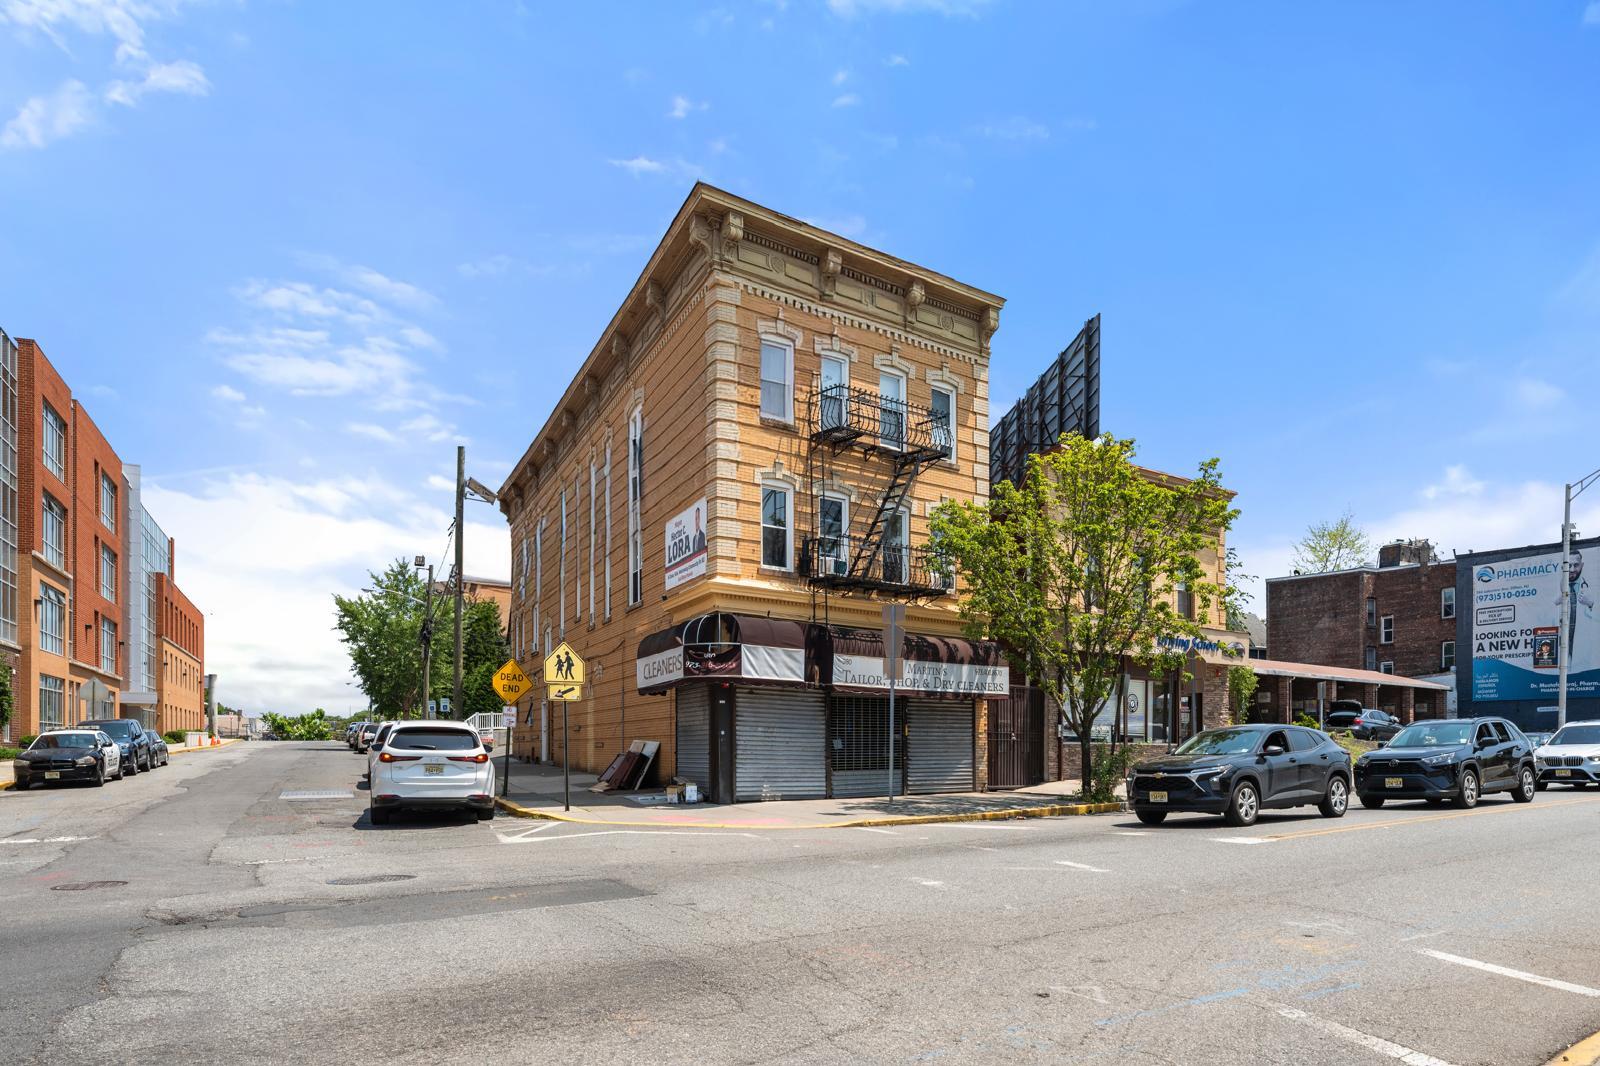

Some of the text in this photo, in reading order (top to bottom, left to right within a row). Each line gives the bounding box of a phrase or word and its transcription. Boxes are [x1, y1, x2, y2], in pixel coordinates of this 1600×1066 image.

[668, 535, 691, 564] LORA
[1497, 563, 1559, 579] PHARMACY
[1476, 588, 1537, 604] (973)510-0250
[1475, 629, 1517, 641] LOOKING
[1520, 628, 1533, 637] FO
[1476, 642, 1486, 653] A
[1489, 639, 1521, 652] NEW
[1505, 652, 1535, 660] PRESCRIPT
[643, 654, 683, 681] CLEANERS
[907, 663, 948, 677] MARTIN'S
[500, 673, 524, 682] DEAD
[842, 669, 1004, 692] TAILOR, HOP, & DRY CLEANERS
[502, 684, 520, 693] END
